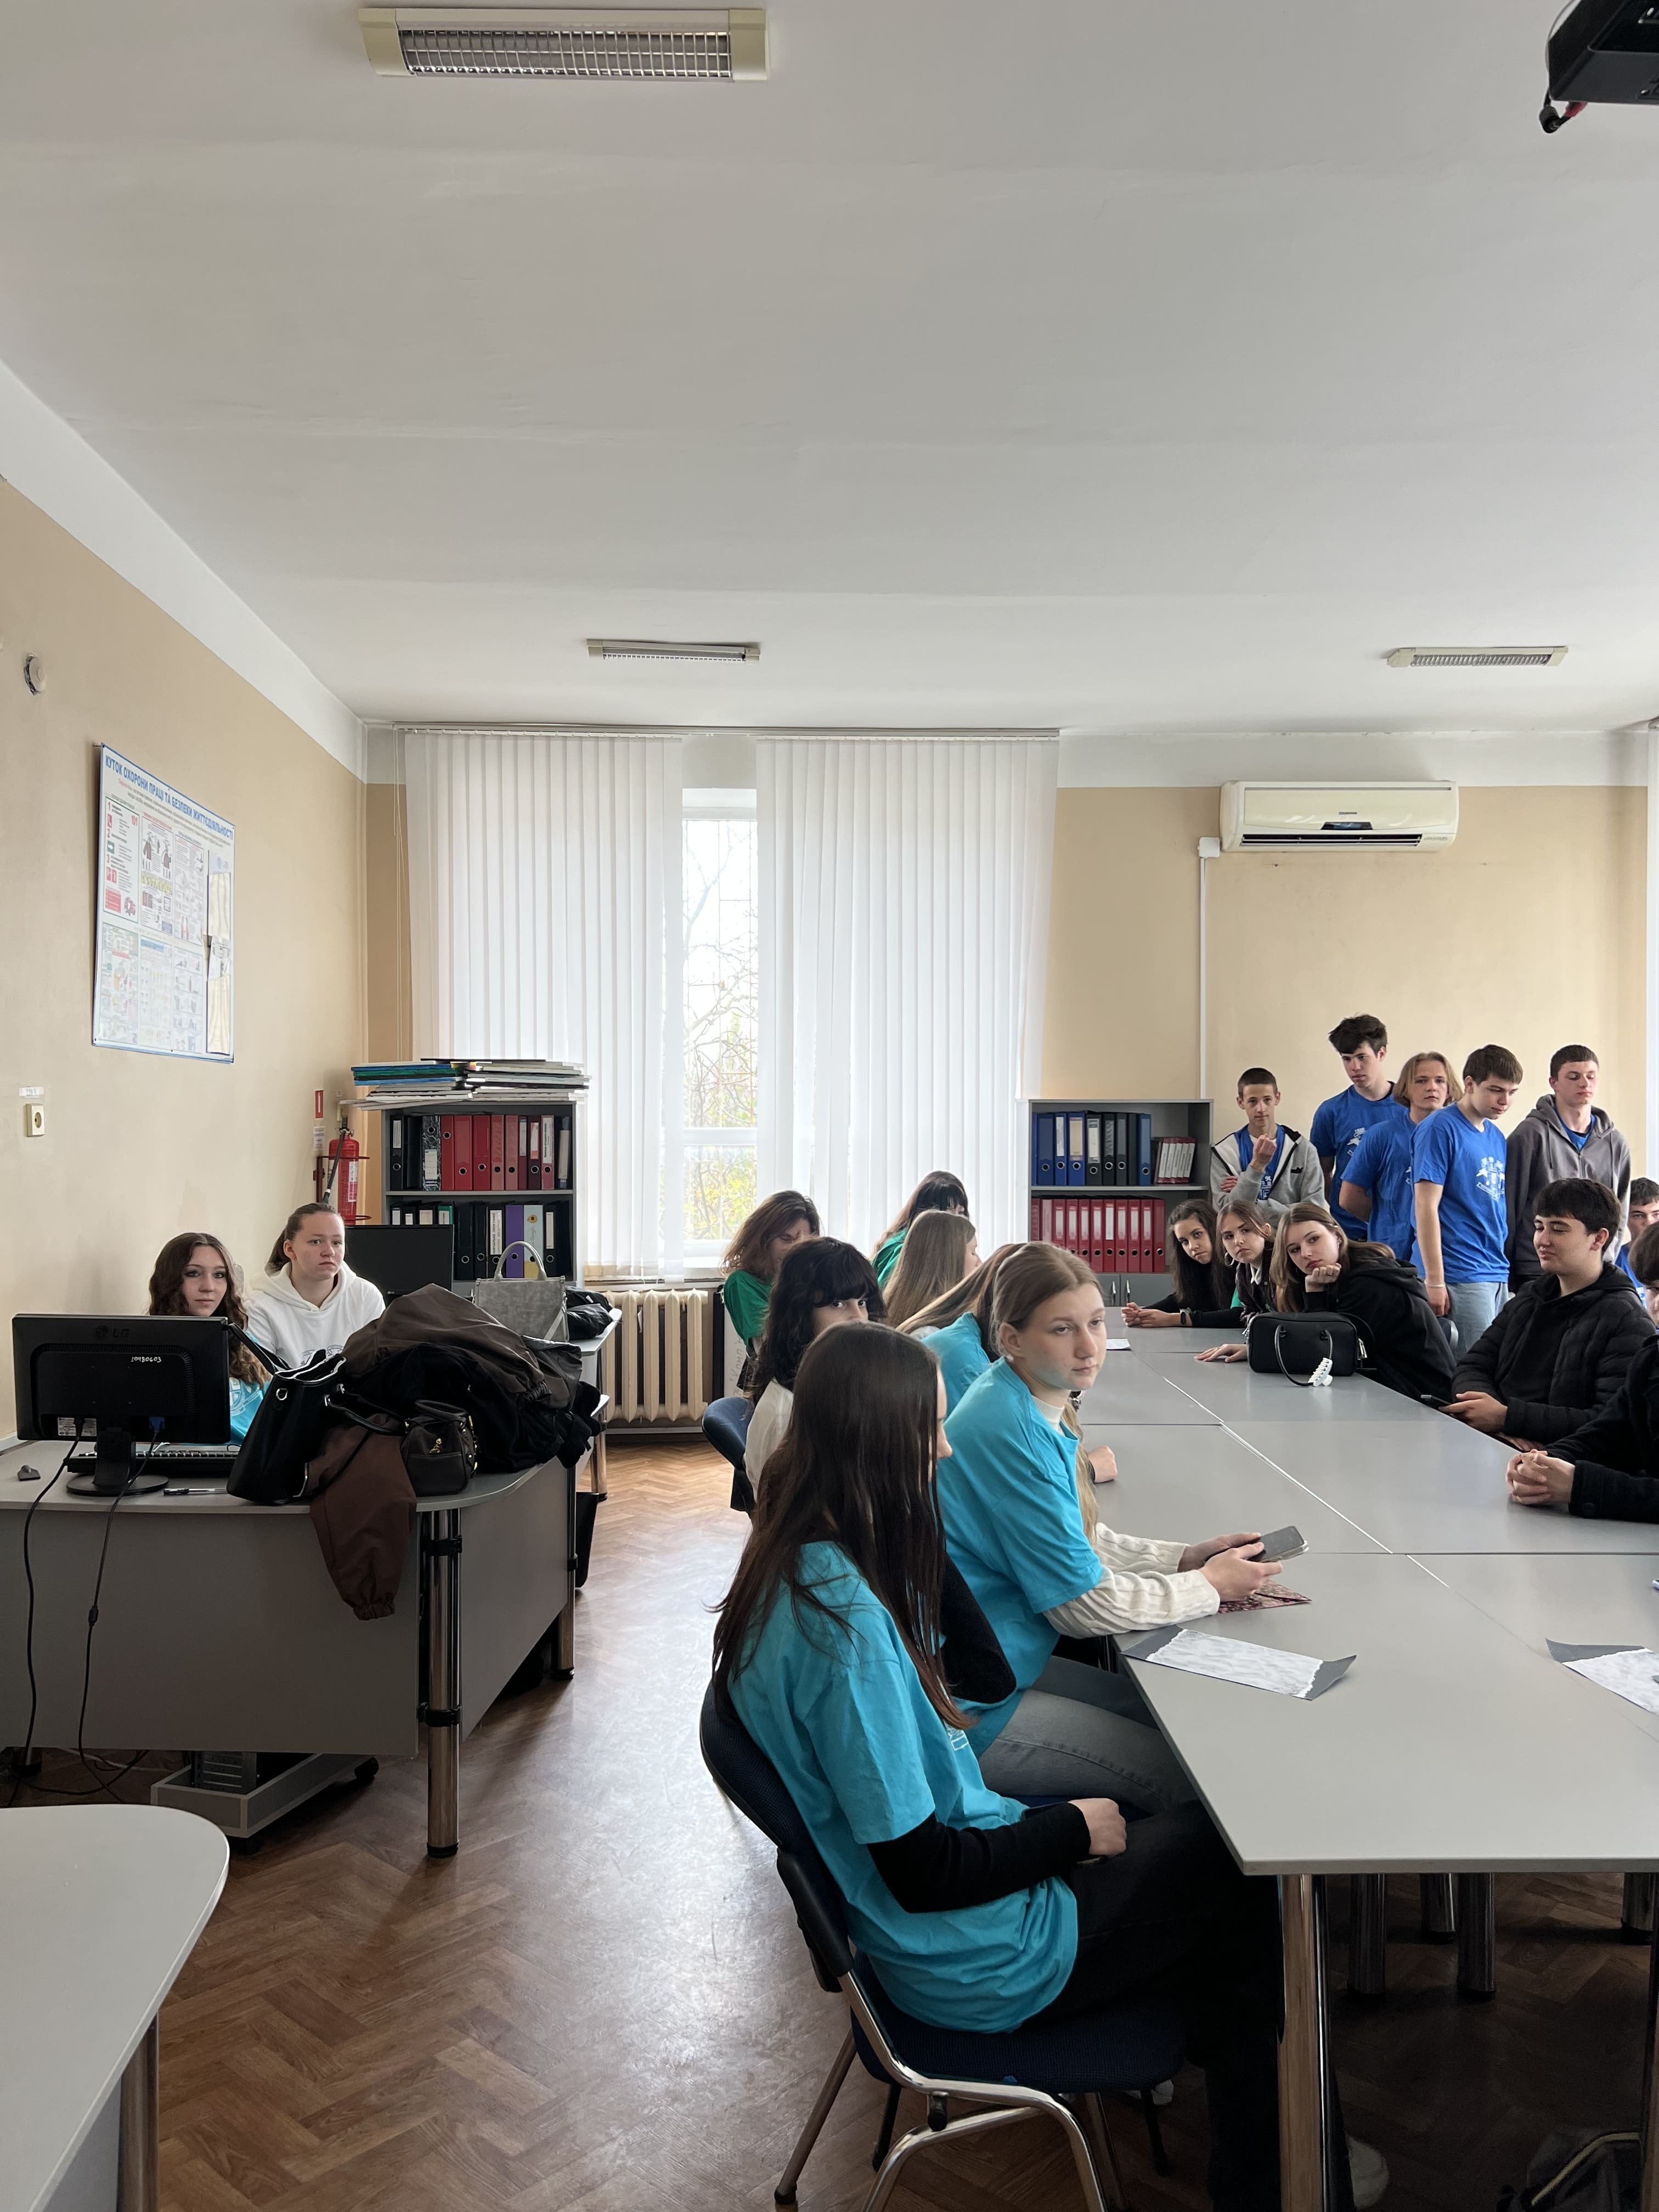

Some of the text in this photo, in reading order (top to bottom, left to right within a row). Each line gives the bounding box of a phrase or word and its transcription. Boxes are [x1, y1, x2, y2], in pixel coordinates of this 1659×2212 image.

[106, 755, 122, 775] КУТОК
[123, 767, 148, 791] ОХОРОНИ
[149, 782, 163, 801] ПРАЦІ
[165, 792, 171, 805] ТА
[172, 796, 192, 817] БЕЗПЕКИ
[113, 1328, 129, 1338] LG
